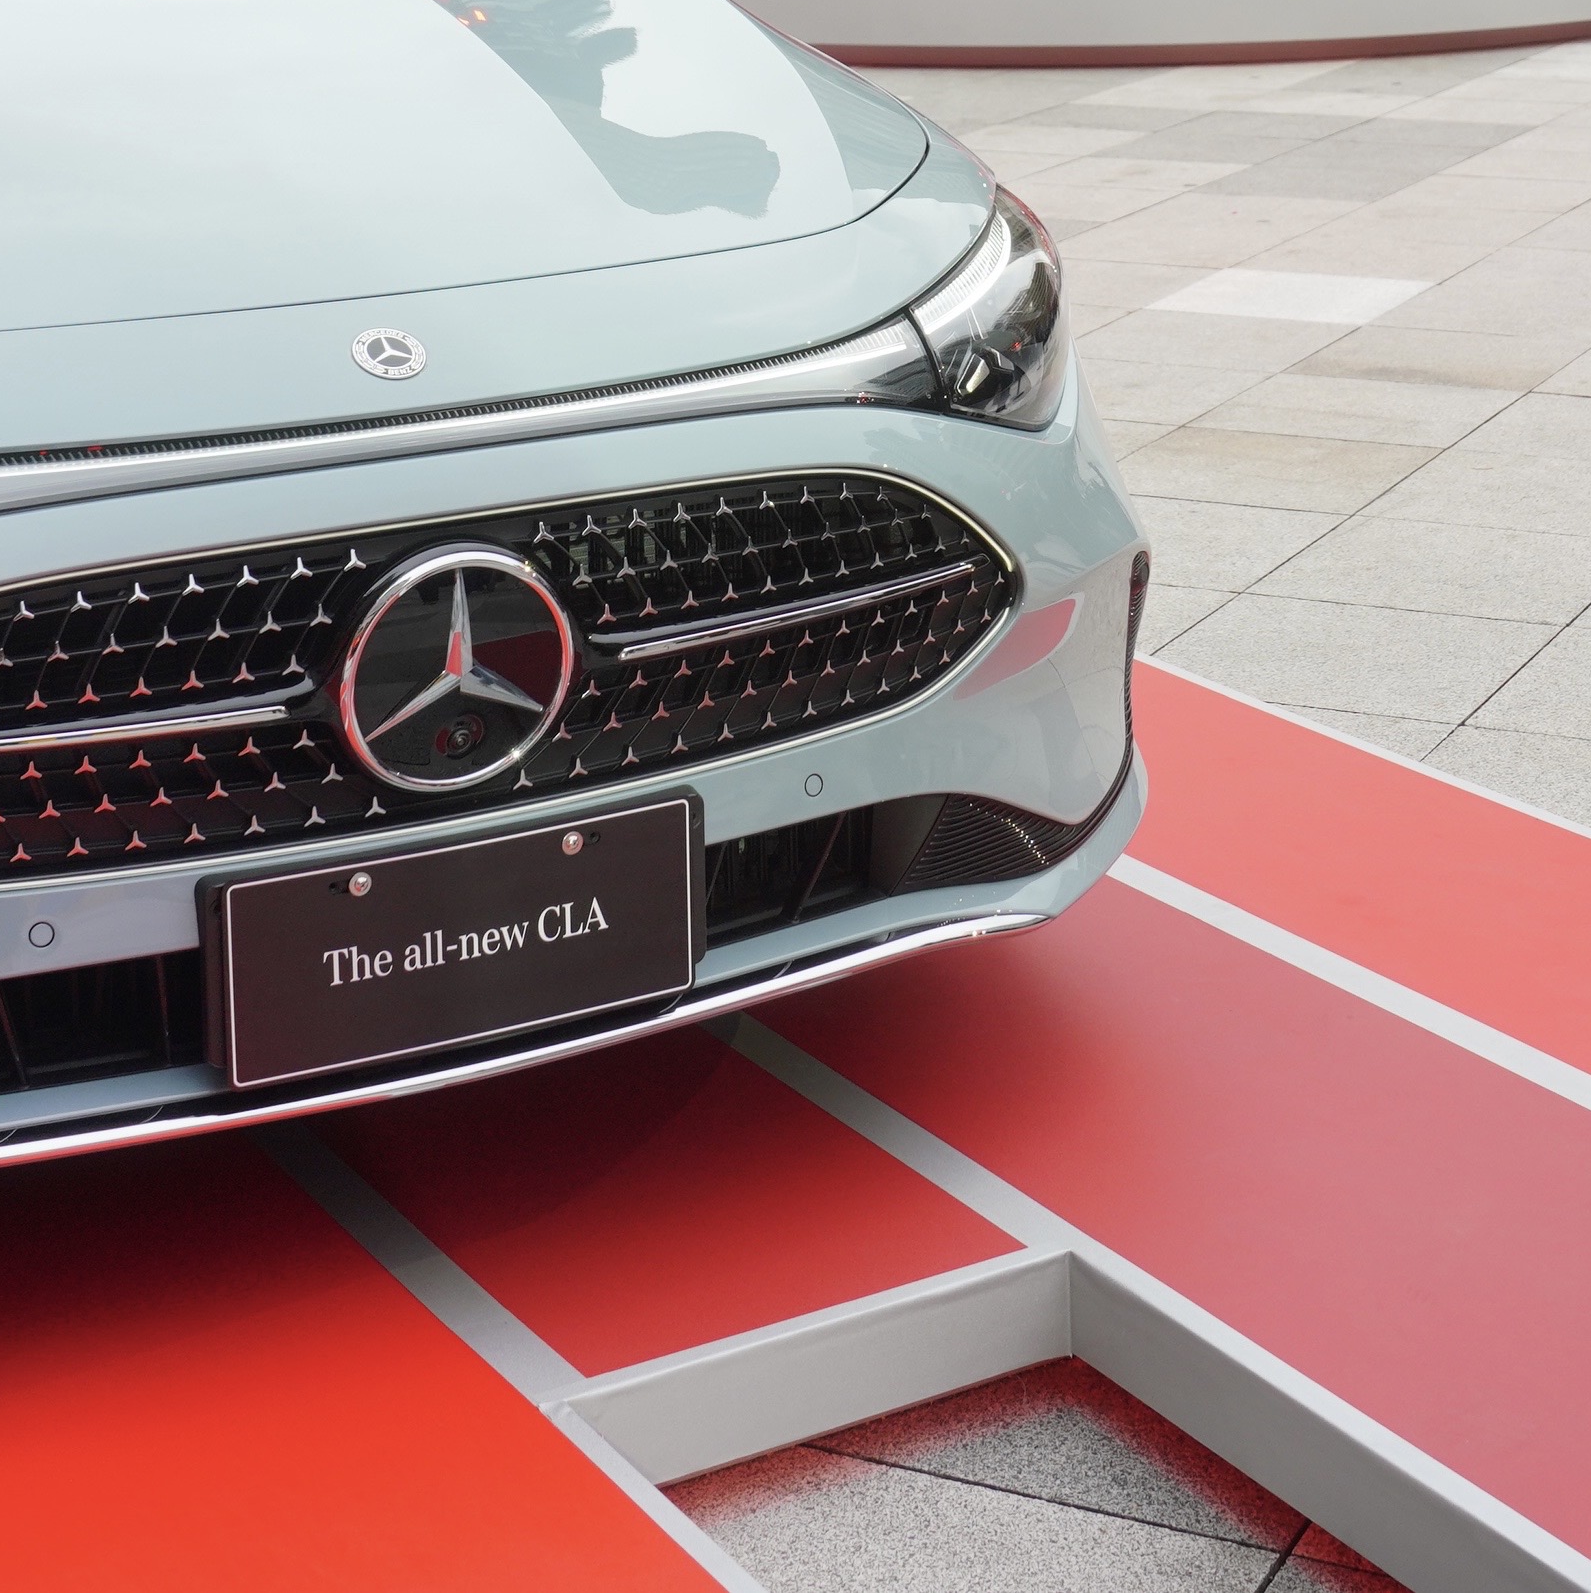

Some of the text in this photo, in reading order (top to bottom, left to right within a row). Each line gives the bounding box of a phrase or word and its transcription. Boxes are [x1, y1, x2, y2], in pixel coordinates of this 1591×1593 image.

[323, 896, 609, 987] The all-new CLA
